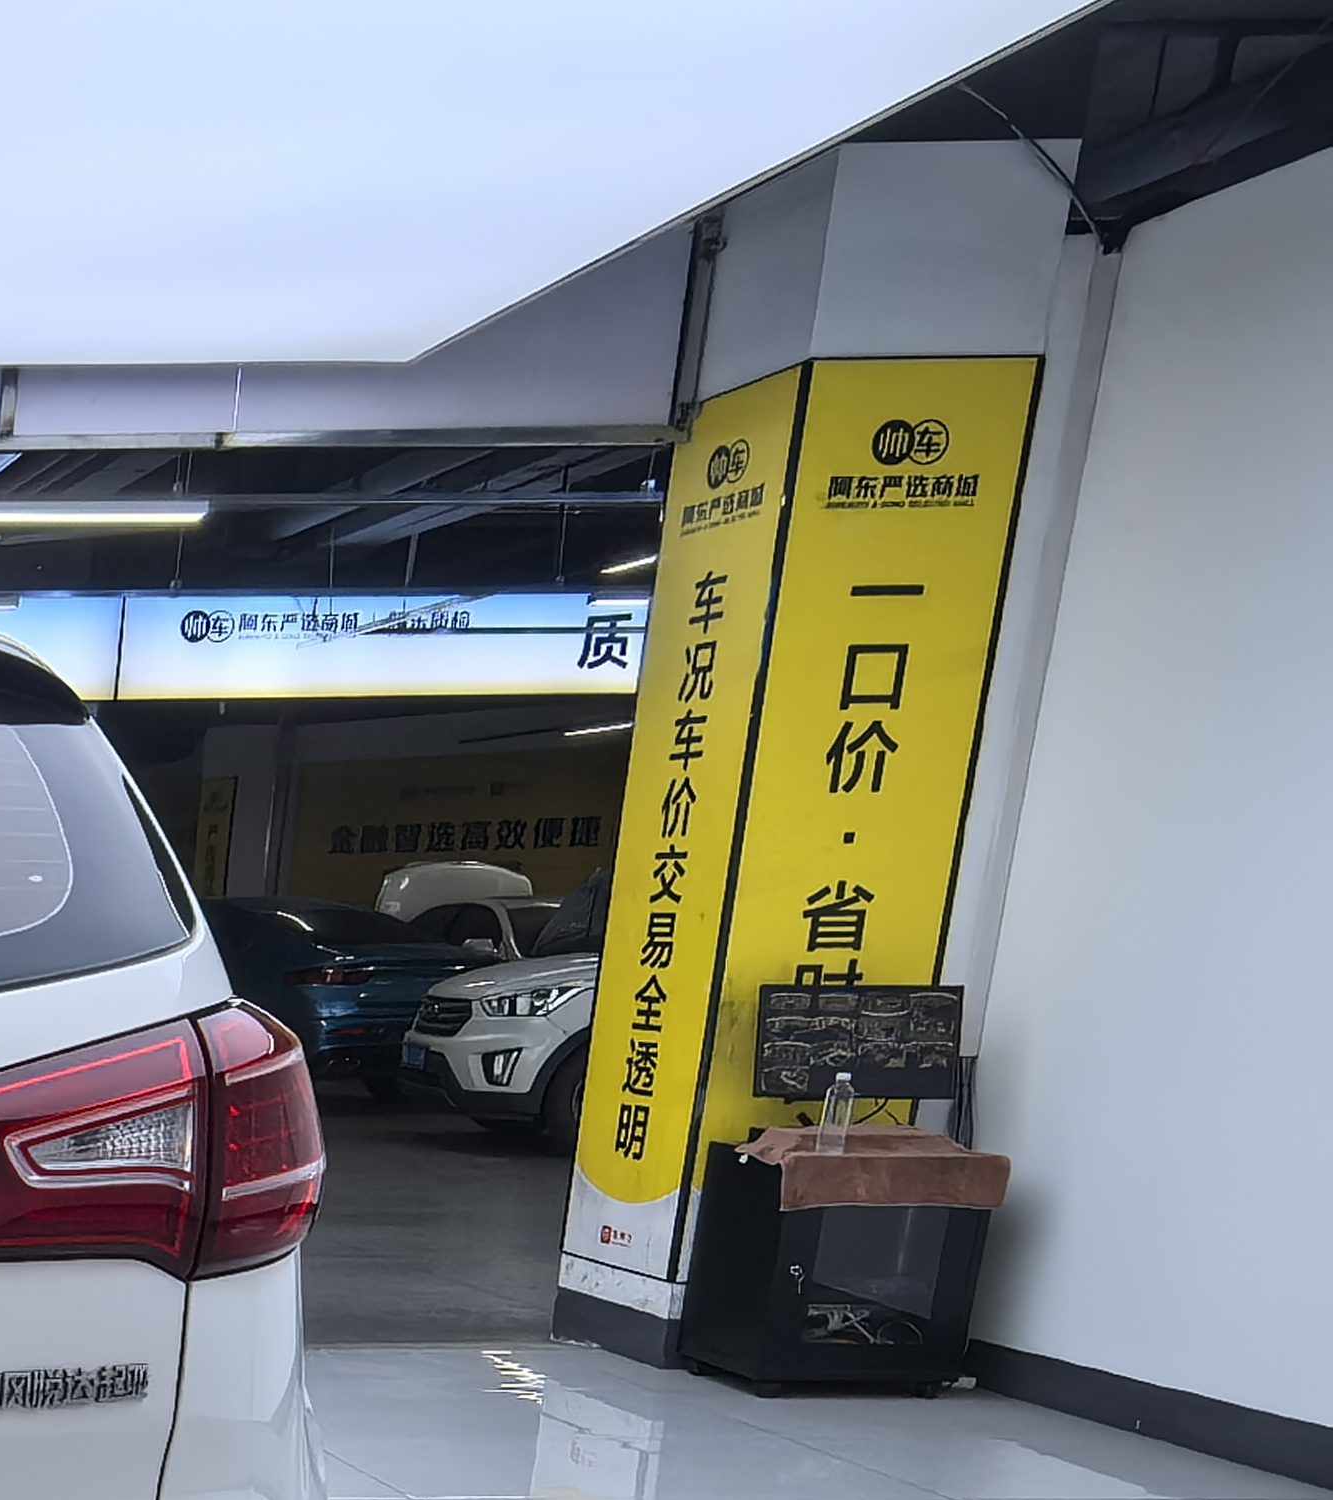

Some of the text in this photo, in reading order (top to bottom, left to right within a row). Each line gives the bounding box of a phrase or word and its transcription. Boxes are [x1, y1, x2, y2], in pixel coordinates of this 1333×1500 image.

[872, 419, 950, 466] 帅车
[827, 473, 980, 499] 阿东严选商城
[577, 612, 633, 670] 质
[615, 570, 729, 1161] 车况车价交易全透明
